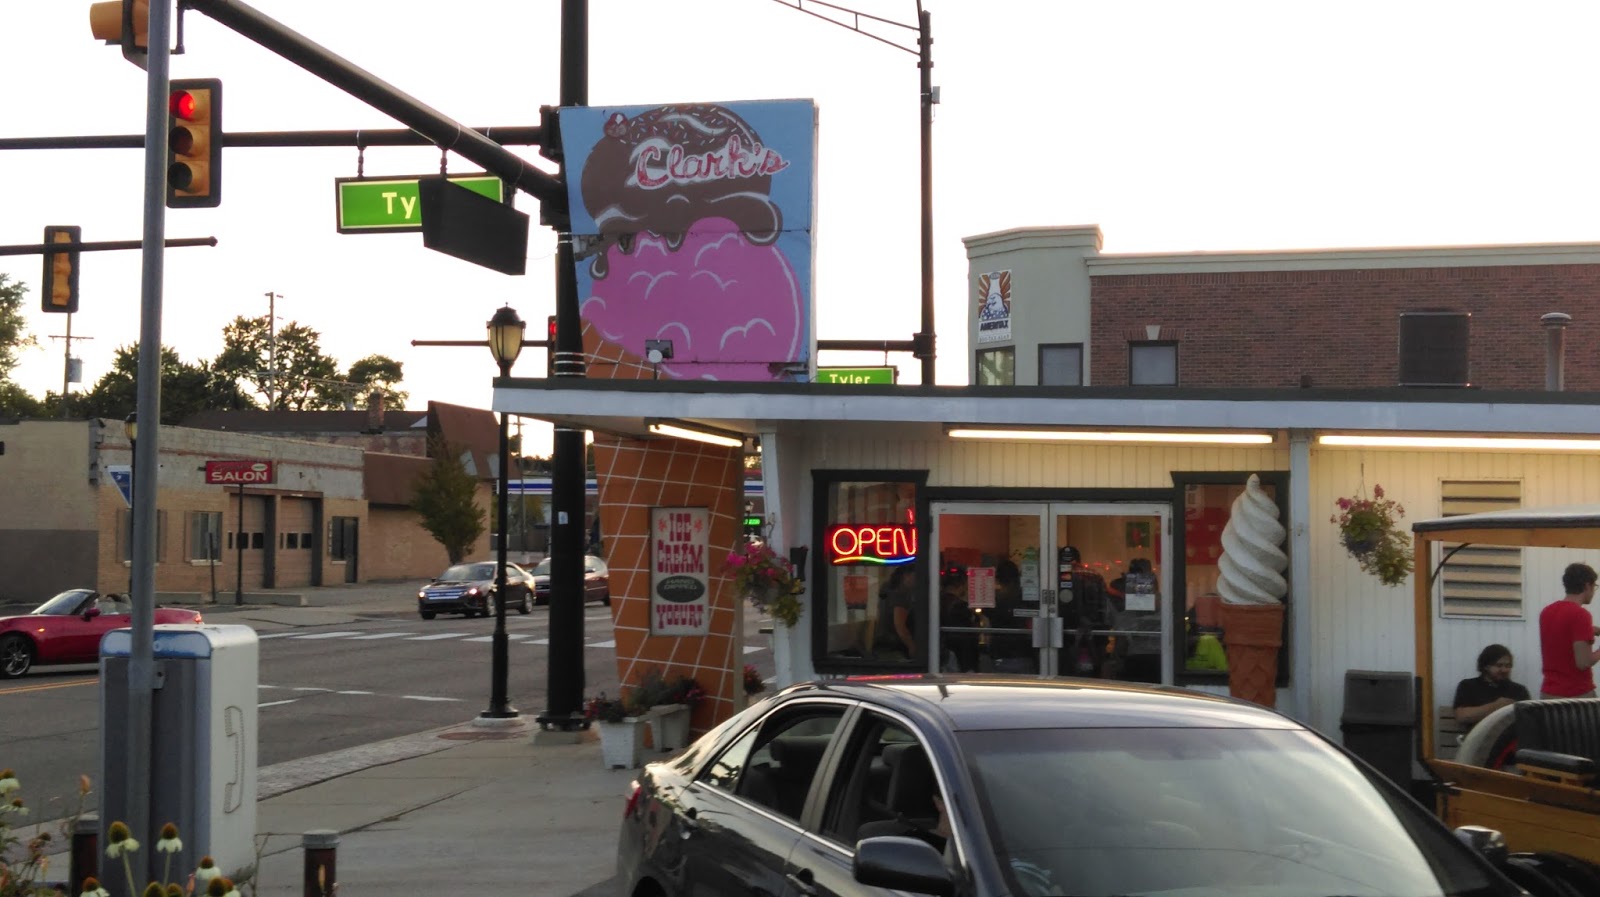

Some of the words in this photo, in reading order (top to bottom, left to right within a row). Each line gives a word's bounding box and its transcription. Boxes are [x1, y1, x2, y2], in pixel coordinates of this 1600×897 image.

[637, 134, 790, 190] Clark's
[382, 192, 416, 219] Ty
[829, 374, 871, 384] Tyler
[211, 471, 268, 481] SALON
[669, 513, 691, 541] ICE
[832, 528, 917, 555] OPEN
[657, 539, 704, 574] CREAM
[656, 604, 704, 629] YOGURT
